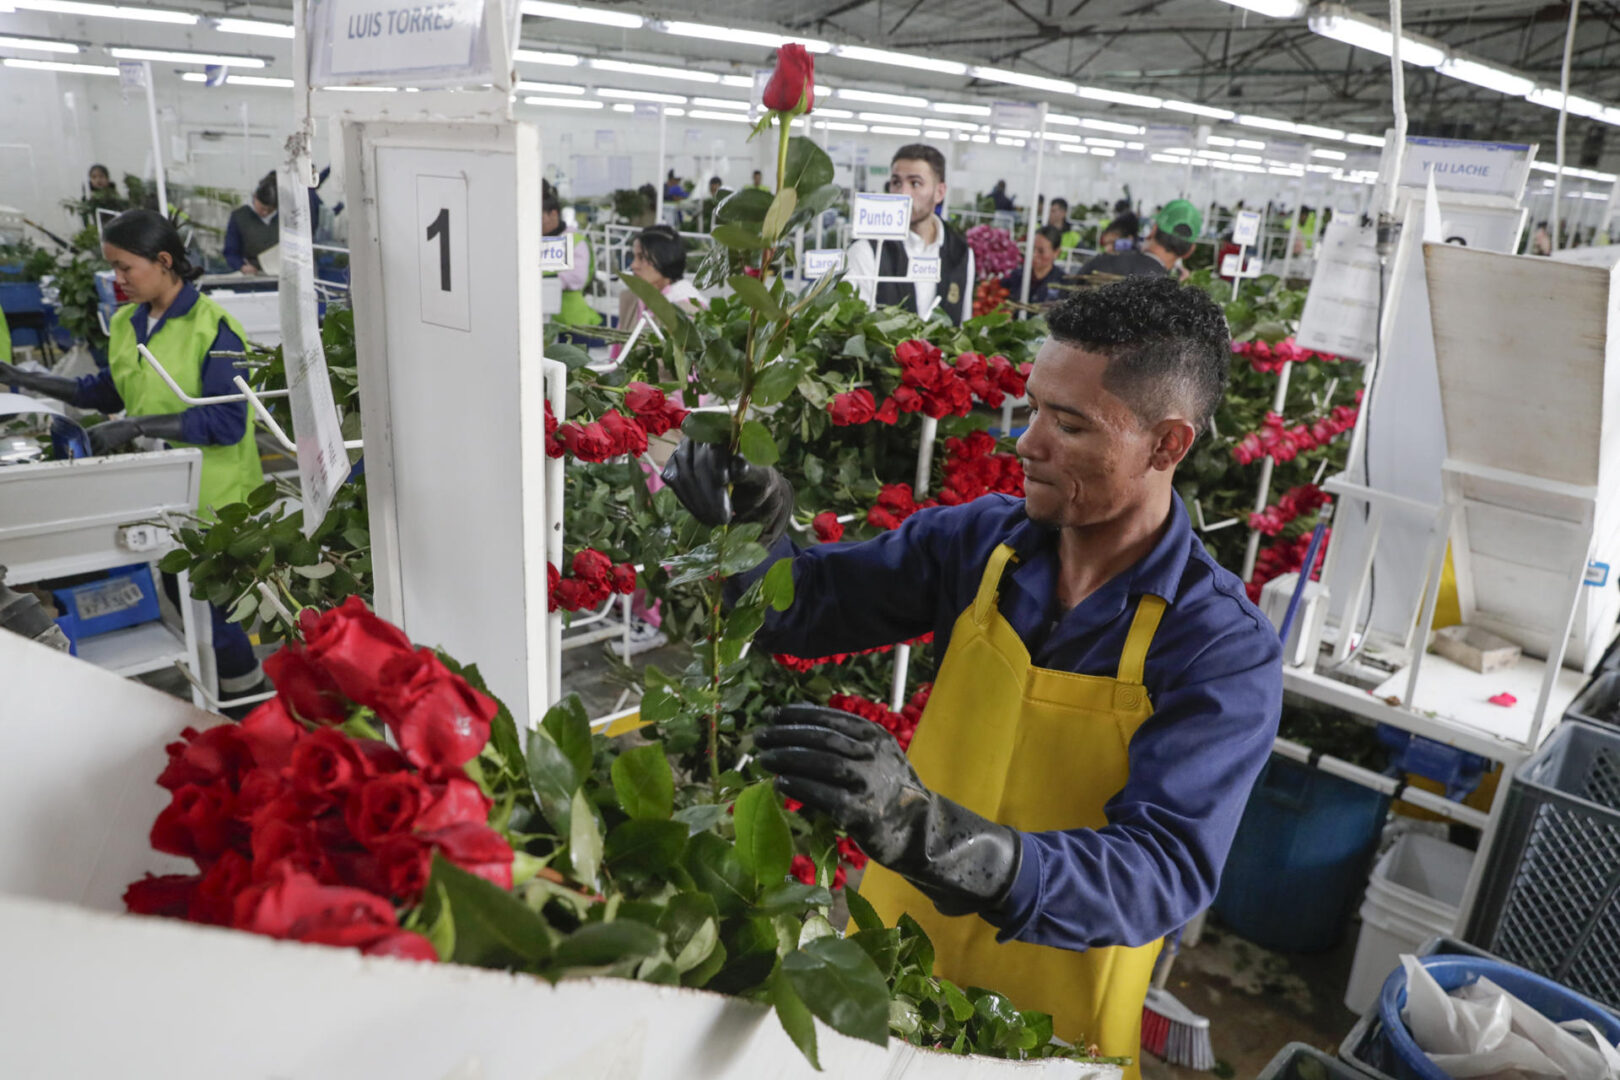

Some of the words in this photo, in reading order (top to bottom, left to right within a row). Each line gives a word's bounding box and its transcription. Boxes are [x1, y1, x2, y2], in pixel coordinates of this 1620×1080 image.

[347, 11, 383, 39] LUIS
[1450, 163, 1491, 177] LACHE
[859, 208, 893, 226] Punto
[897, 210, 904, 226] 3
[426, 208, 452, 292] 1
[912, 263, 937, 274] Corto
